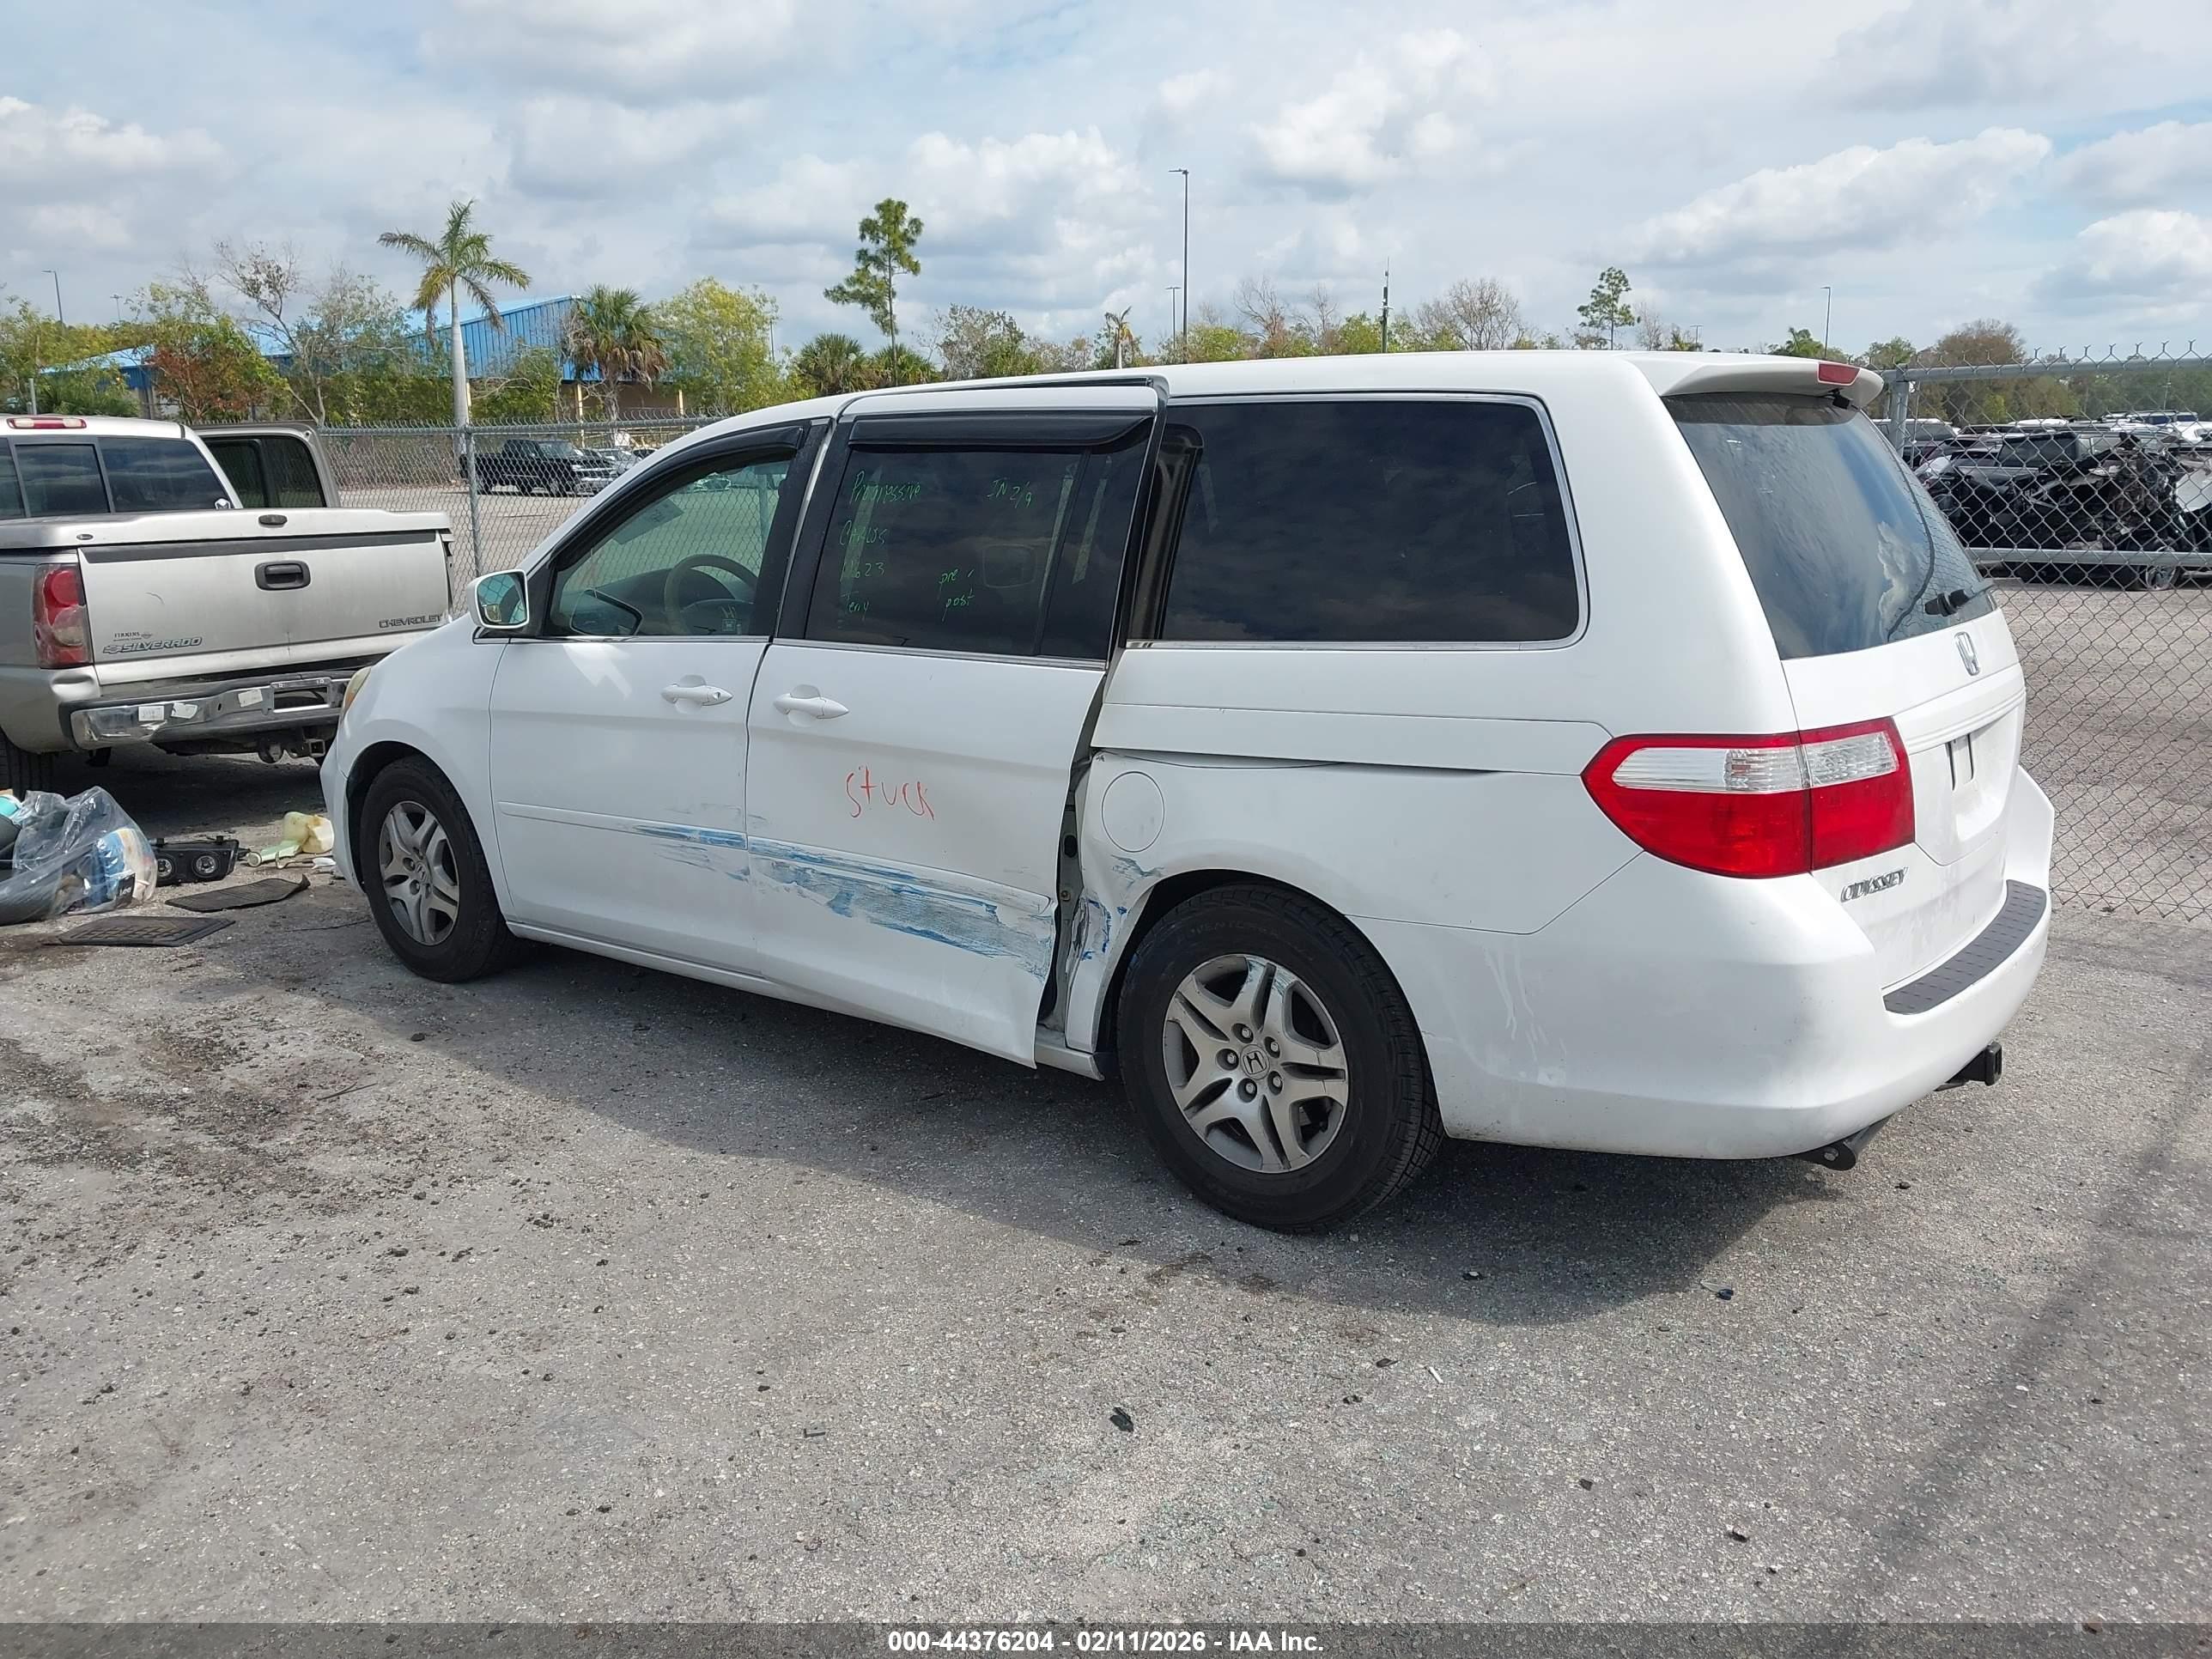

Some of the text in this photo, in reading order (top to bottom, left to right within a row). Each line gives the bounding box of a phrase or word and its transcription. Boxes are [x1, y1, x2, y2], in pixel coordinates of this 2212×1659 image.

[379, 613, 443, 629] CHEVROLET
[119, 636, 204, 653] SILVERADO
[1840, 866, 1909, 903] ODYSSEY
